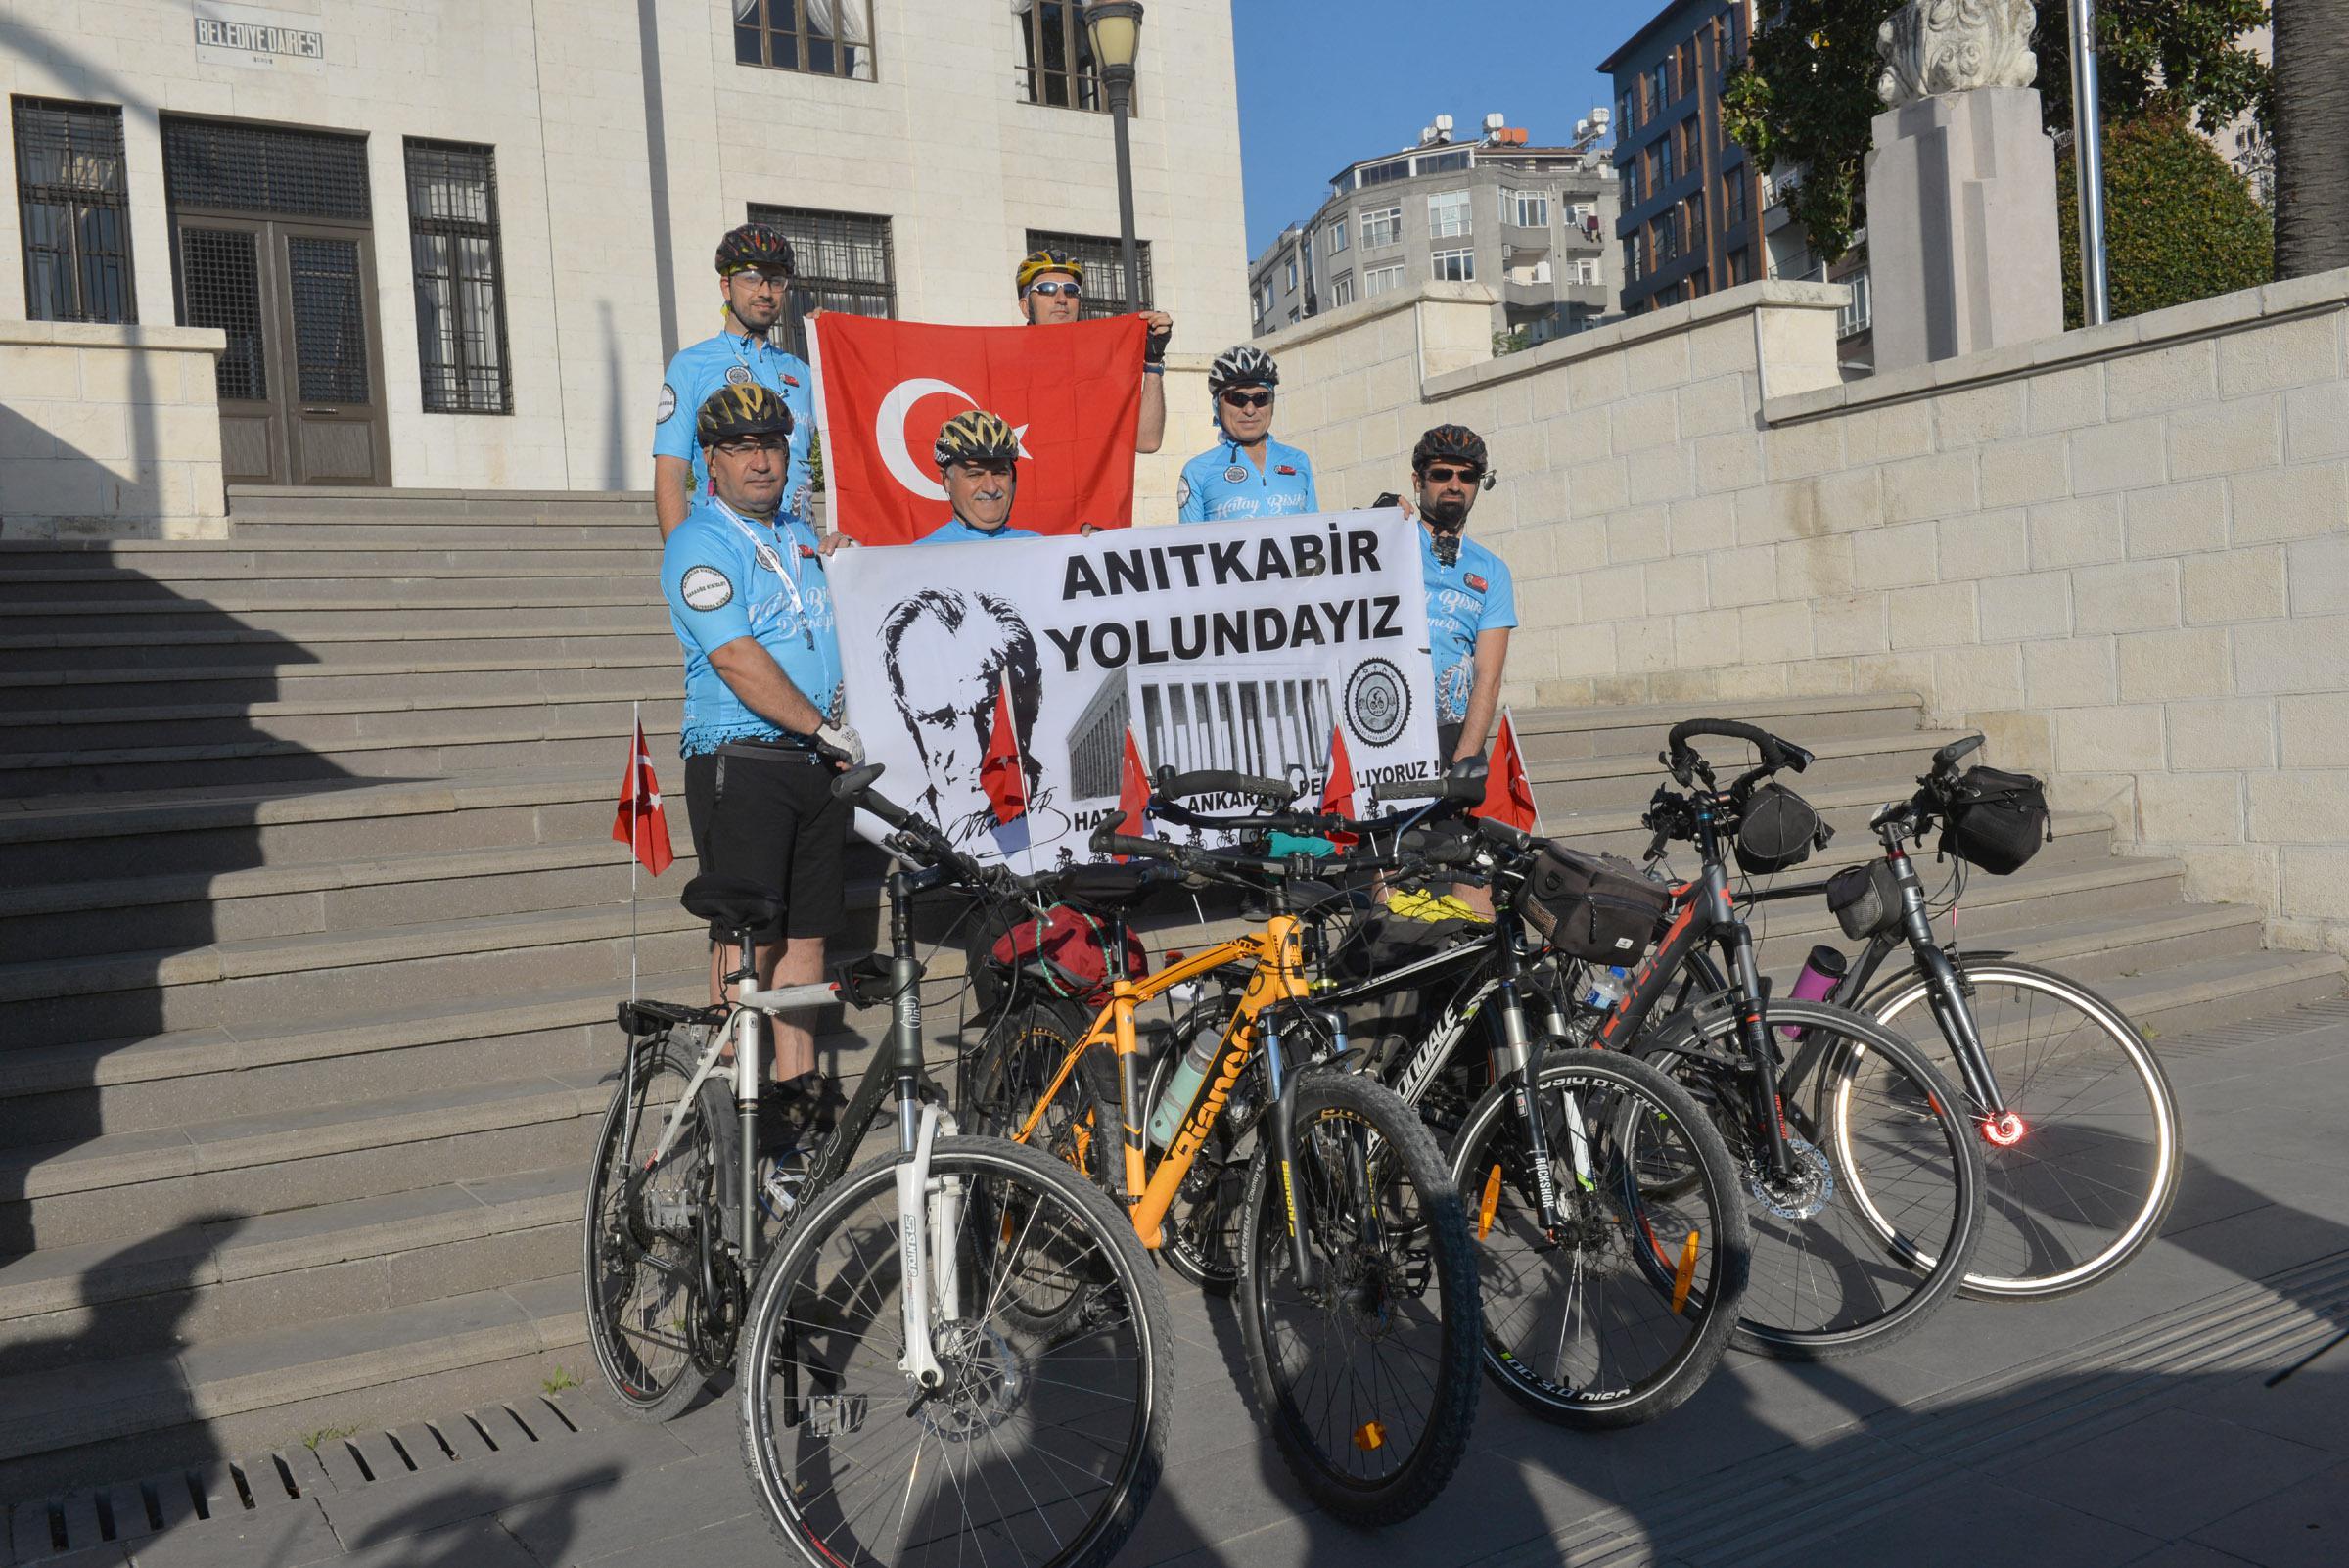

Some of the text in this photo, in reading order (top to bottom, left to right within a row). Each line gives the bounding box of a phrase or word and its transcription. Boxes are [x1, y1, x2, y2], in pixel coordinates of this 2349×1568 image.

[1062, 522, 1382, 601] ANITKABİR
[1043, 595, 1403, 672] YOLUNDAYIZ
[1535, 1157, 1555, 1208] ROCKSHOX
[1241, 1205, 1252, 1262] MICHELIN
[744, 1426, 760, 1480] SCHWALBE
